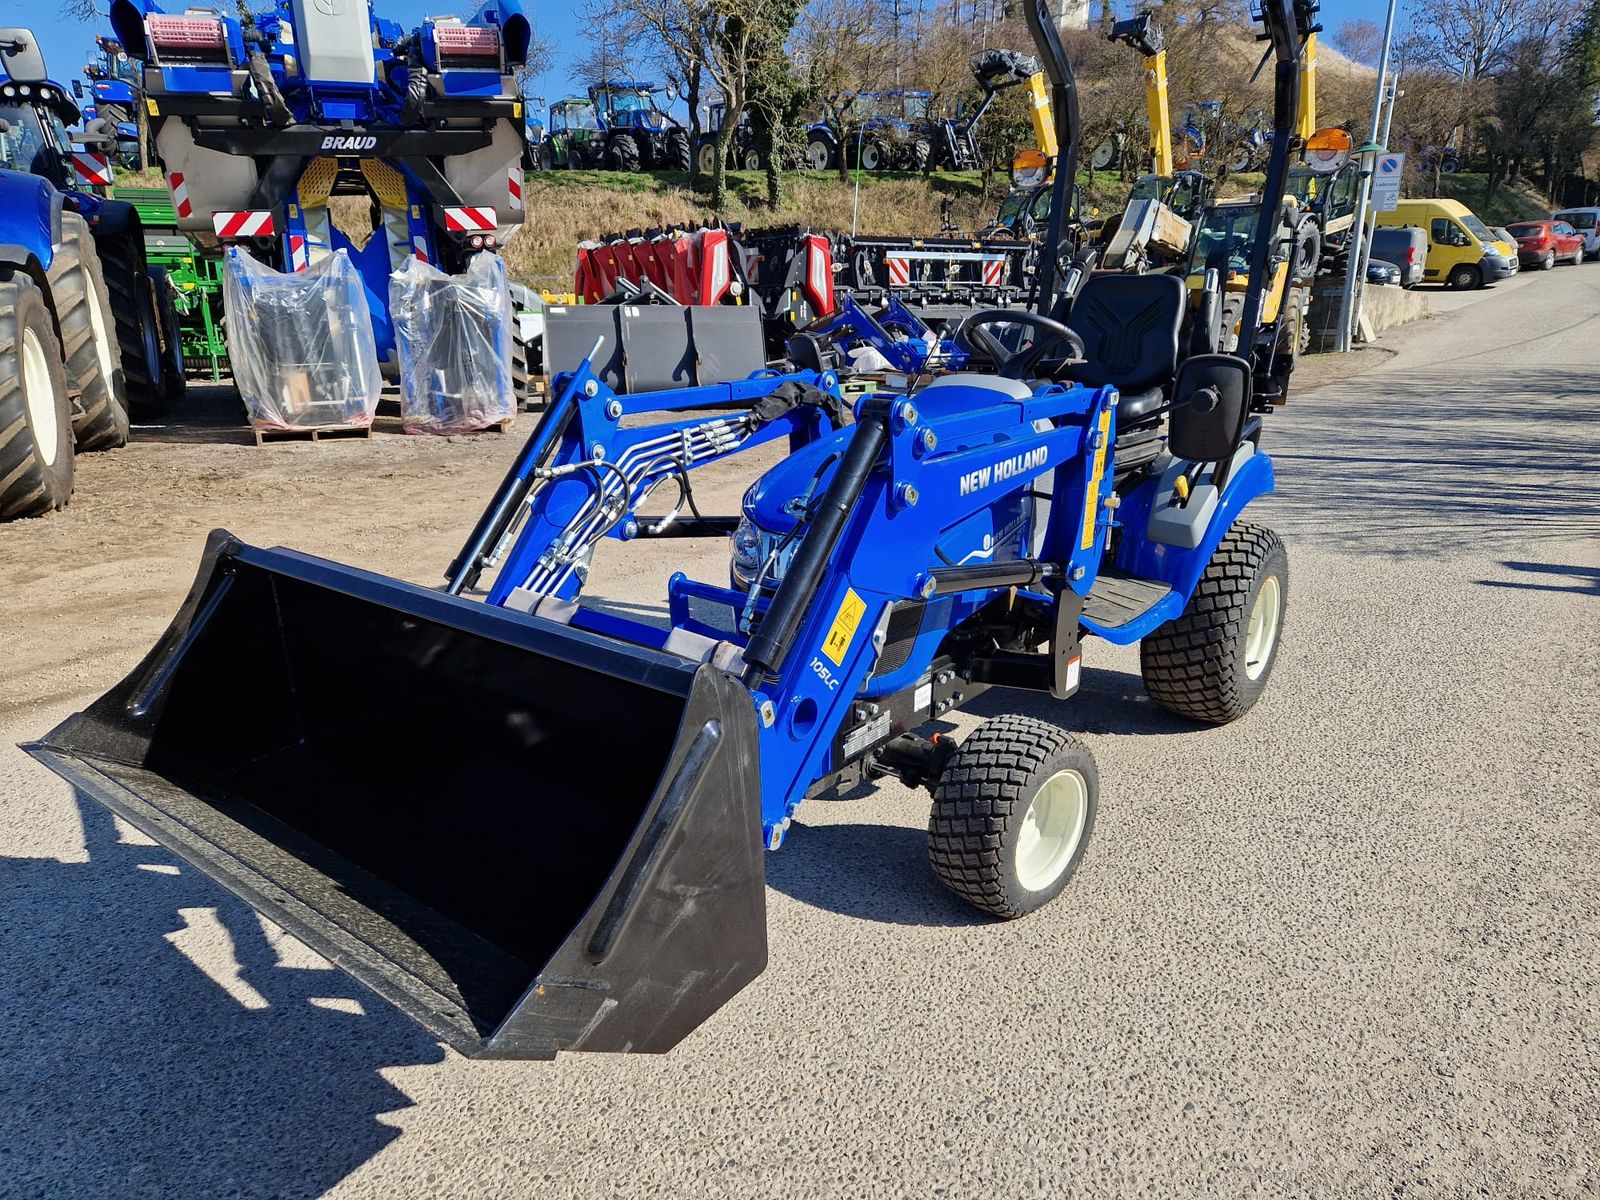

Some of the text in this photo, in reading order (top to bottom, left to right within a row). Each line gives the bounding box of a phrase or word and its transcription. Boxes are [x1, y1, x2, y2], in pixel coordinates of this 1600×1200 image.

[321, 136, 377, 150] BRAUD
[960, 445, 1048, 497] NEW HOLLAND
[809, 656, 840, 691] 105LC
